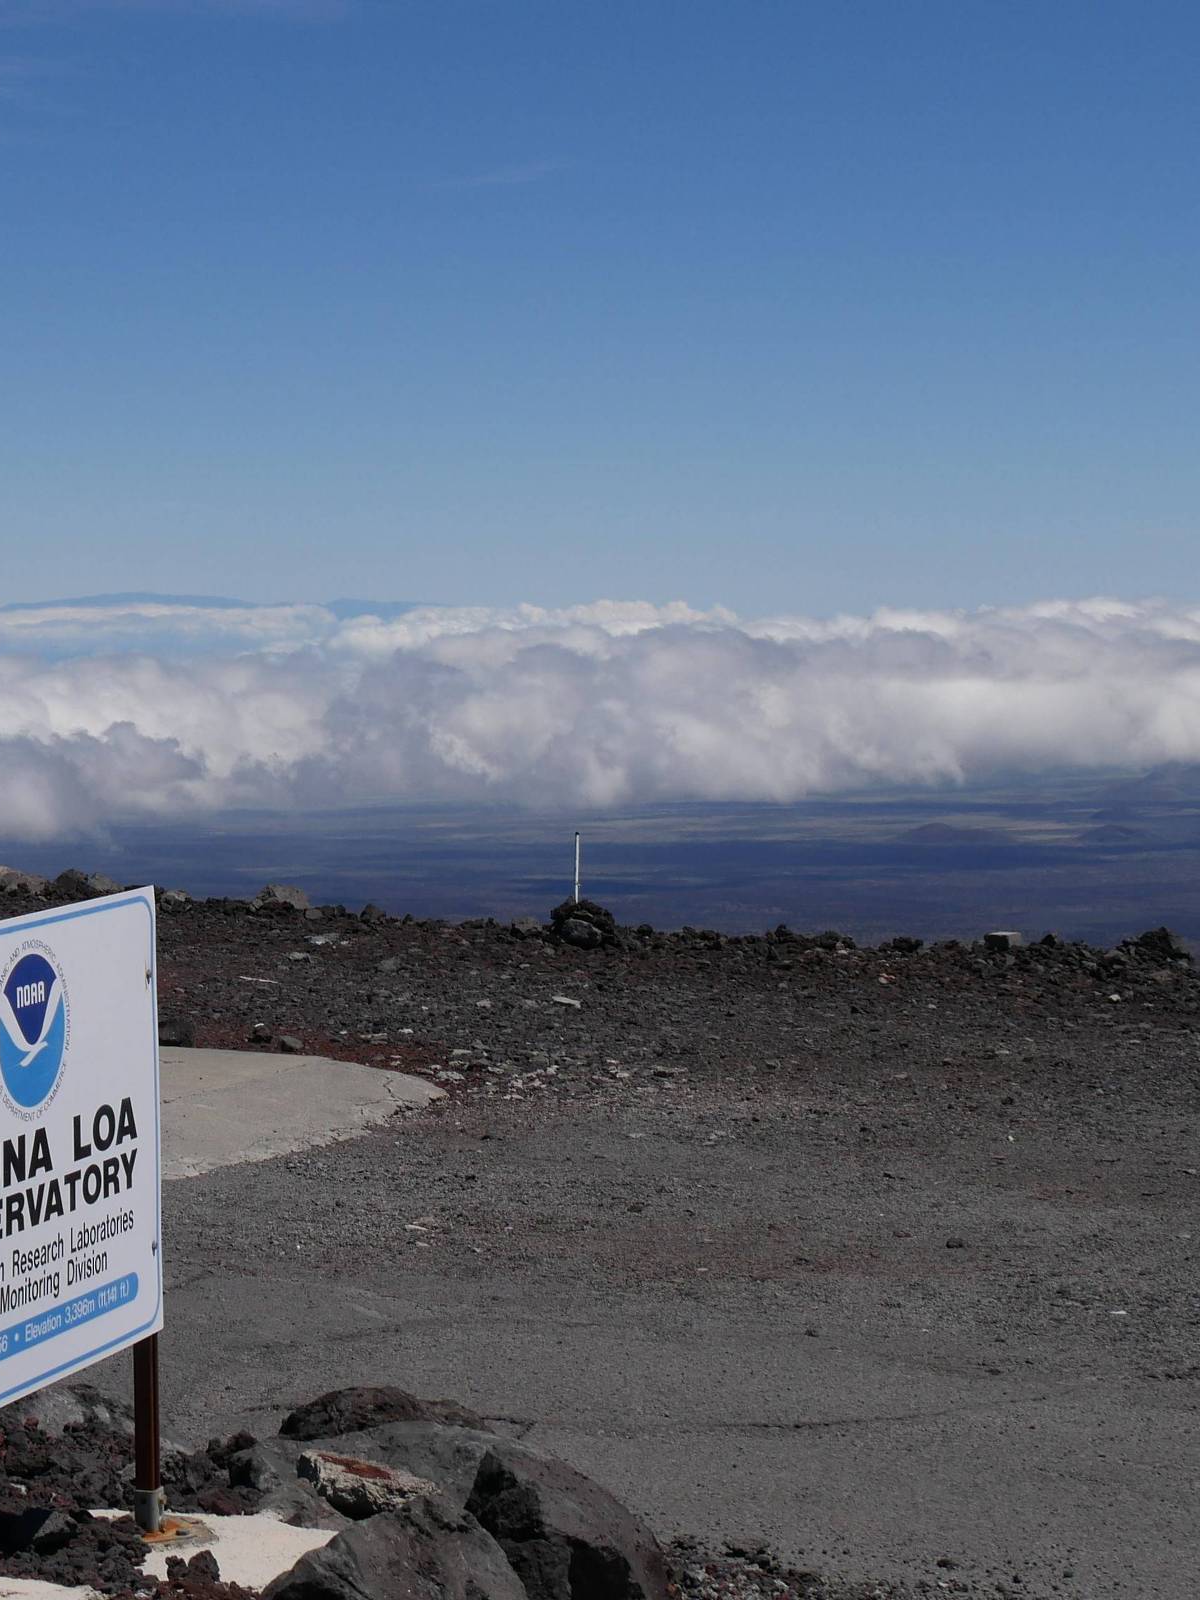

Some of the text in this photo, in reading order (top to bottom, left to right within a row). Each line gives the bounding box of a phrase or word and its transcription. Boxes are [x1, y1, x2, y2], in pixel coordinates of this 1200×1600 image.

[9, 947, 20, 963] AND
[16, 980, 45, 1009] NOAA
[2, 1094, 35, 1122] DEPARTMENT
[73, 1096, 138, 1162] LOA
[12, 1233, 64, 1277] Research
[70, 1208, 134, 1252] Laboratories
[0, 1271, 60, 1315] Monitoring
[67, 1250, 108, 1286] Division
[24, 1314, 62, 1342] Elevation
[64, 1300, 95, 1325] 3,396m
